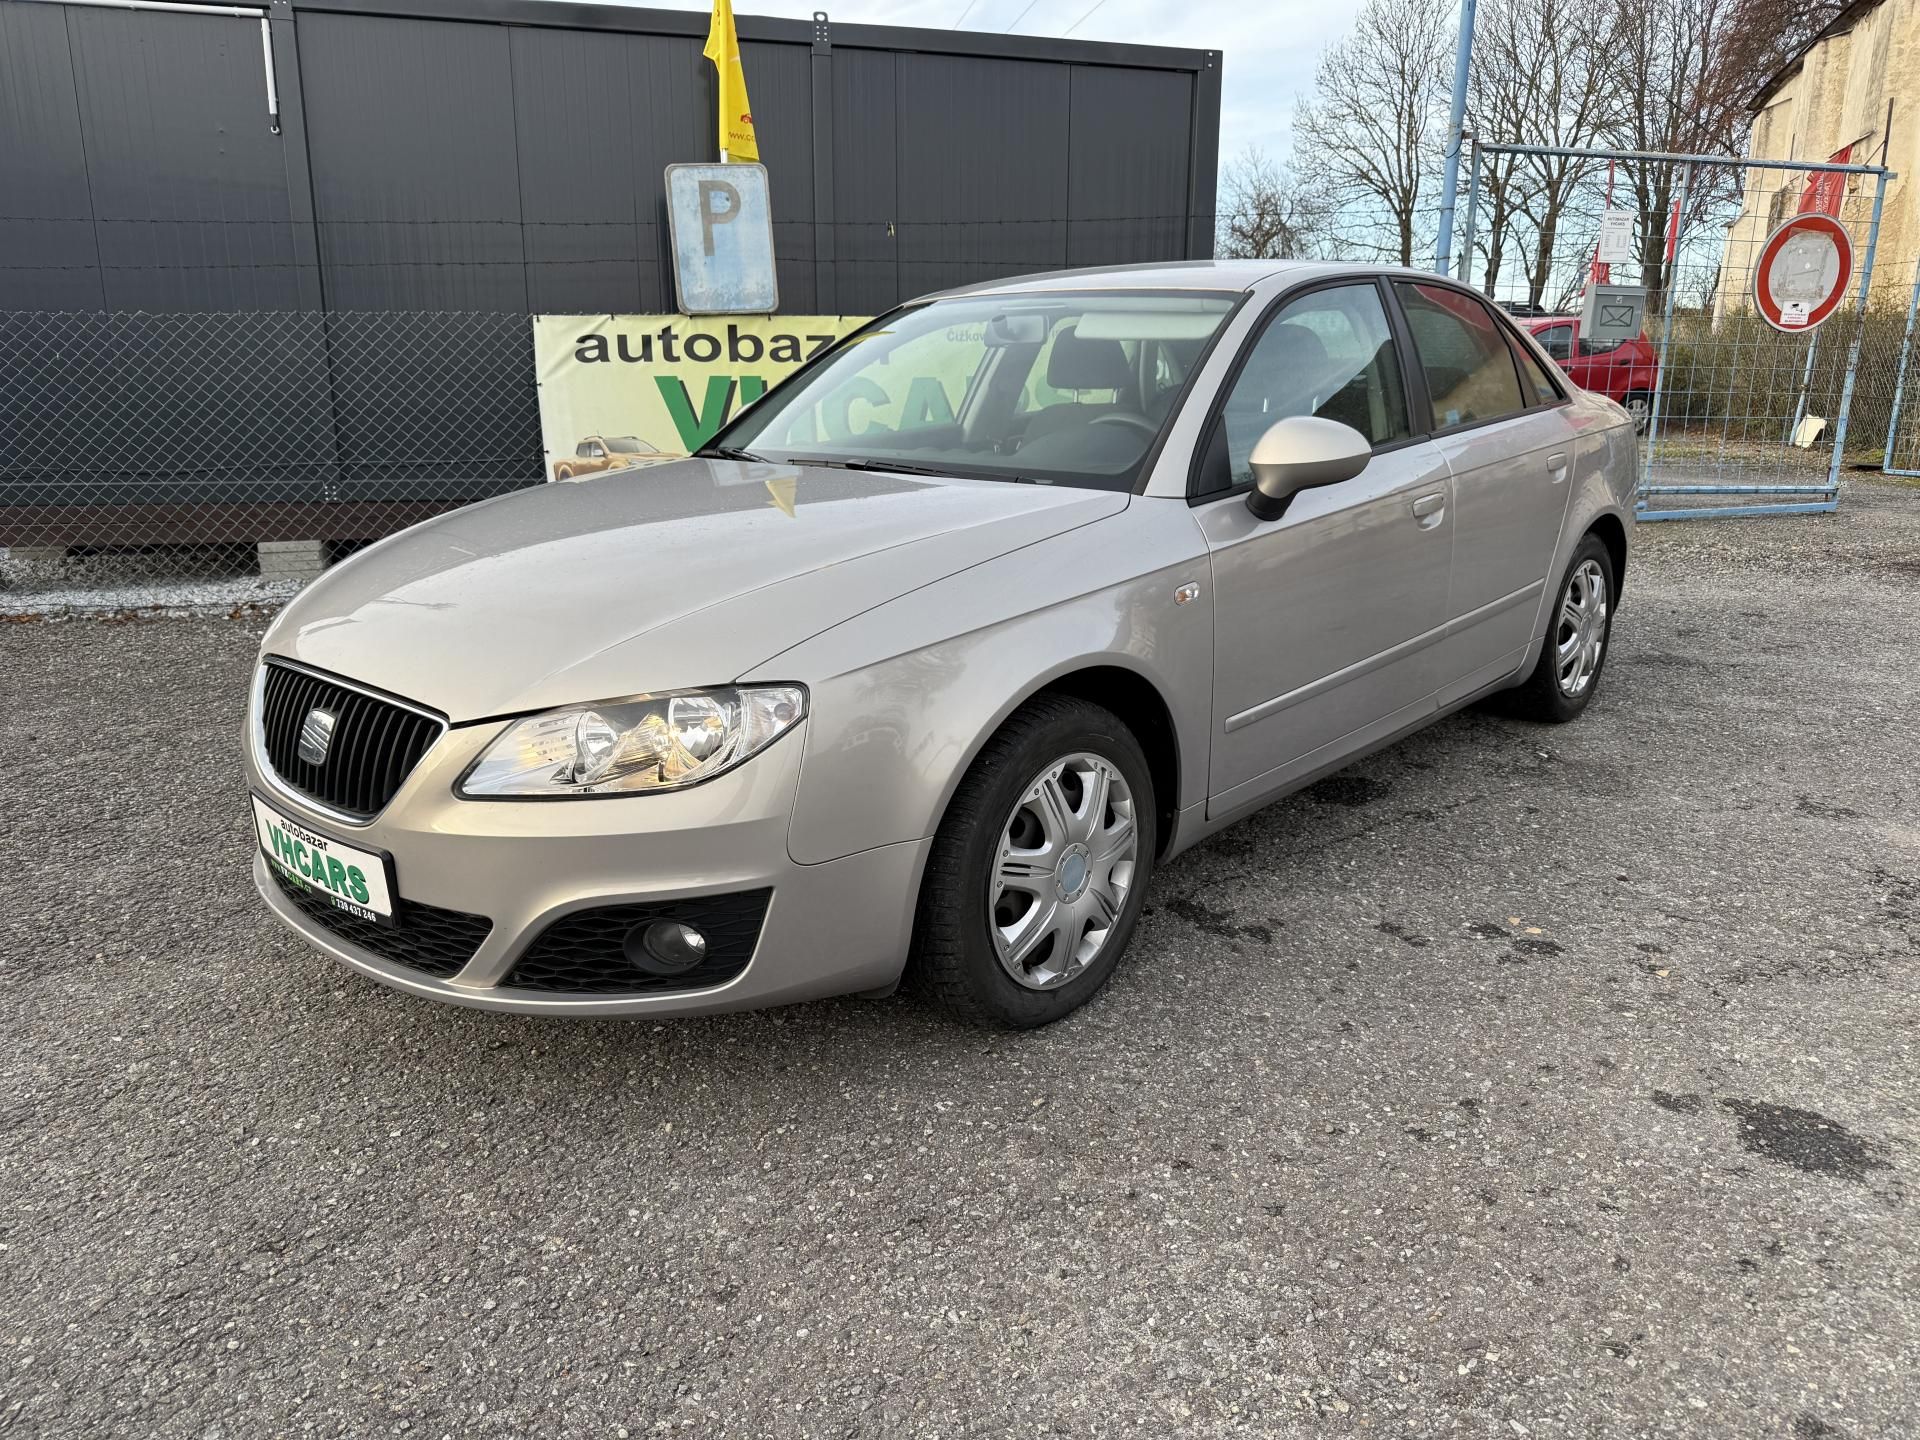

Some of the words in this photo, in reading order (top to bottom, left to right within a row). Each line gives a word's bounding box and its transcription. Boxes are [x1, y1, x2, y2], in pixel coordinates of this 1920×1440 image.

[698, 180, 741, 256] P
[574, 325, 889, 365] autobaz
[265, 819, 369, 904] VHCARS
[280, 819, 328, 851] autobazar
